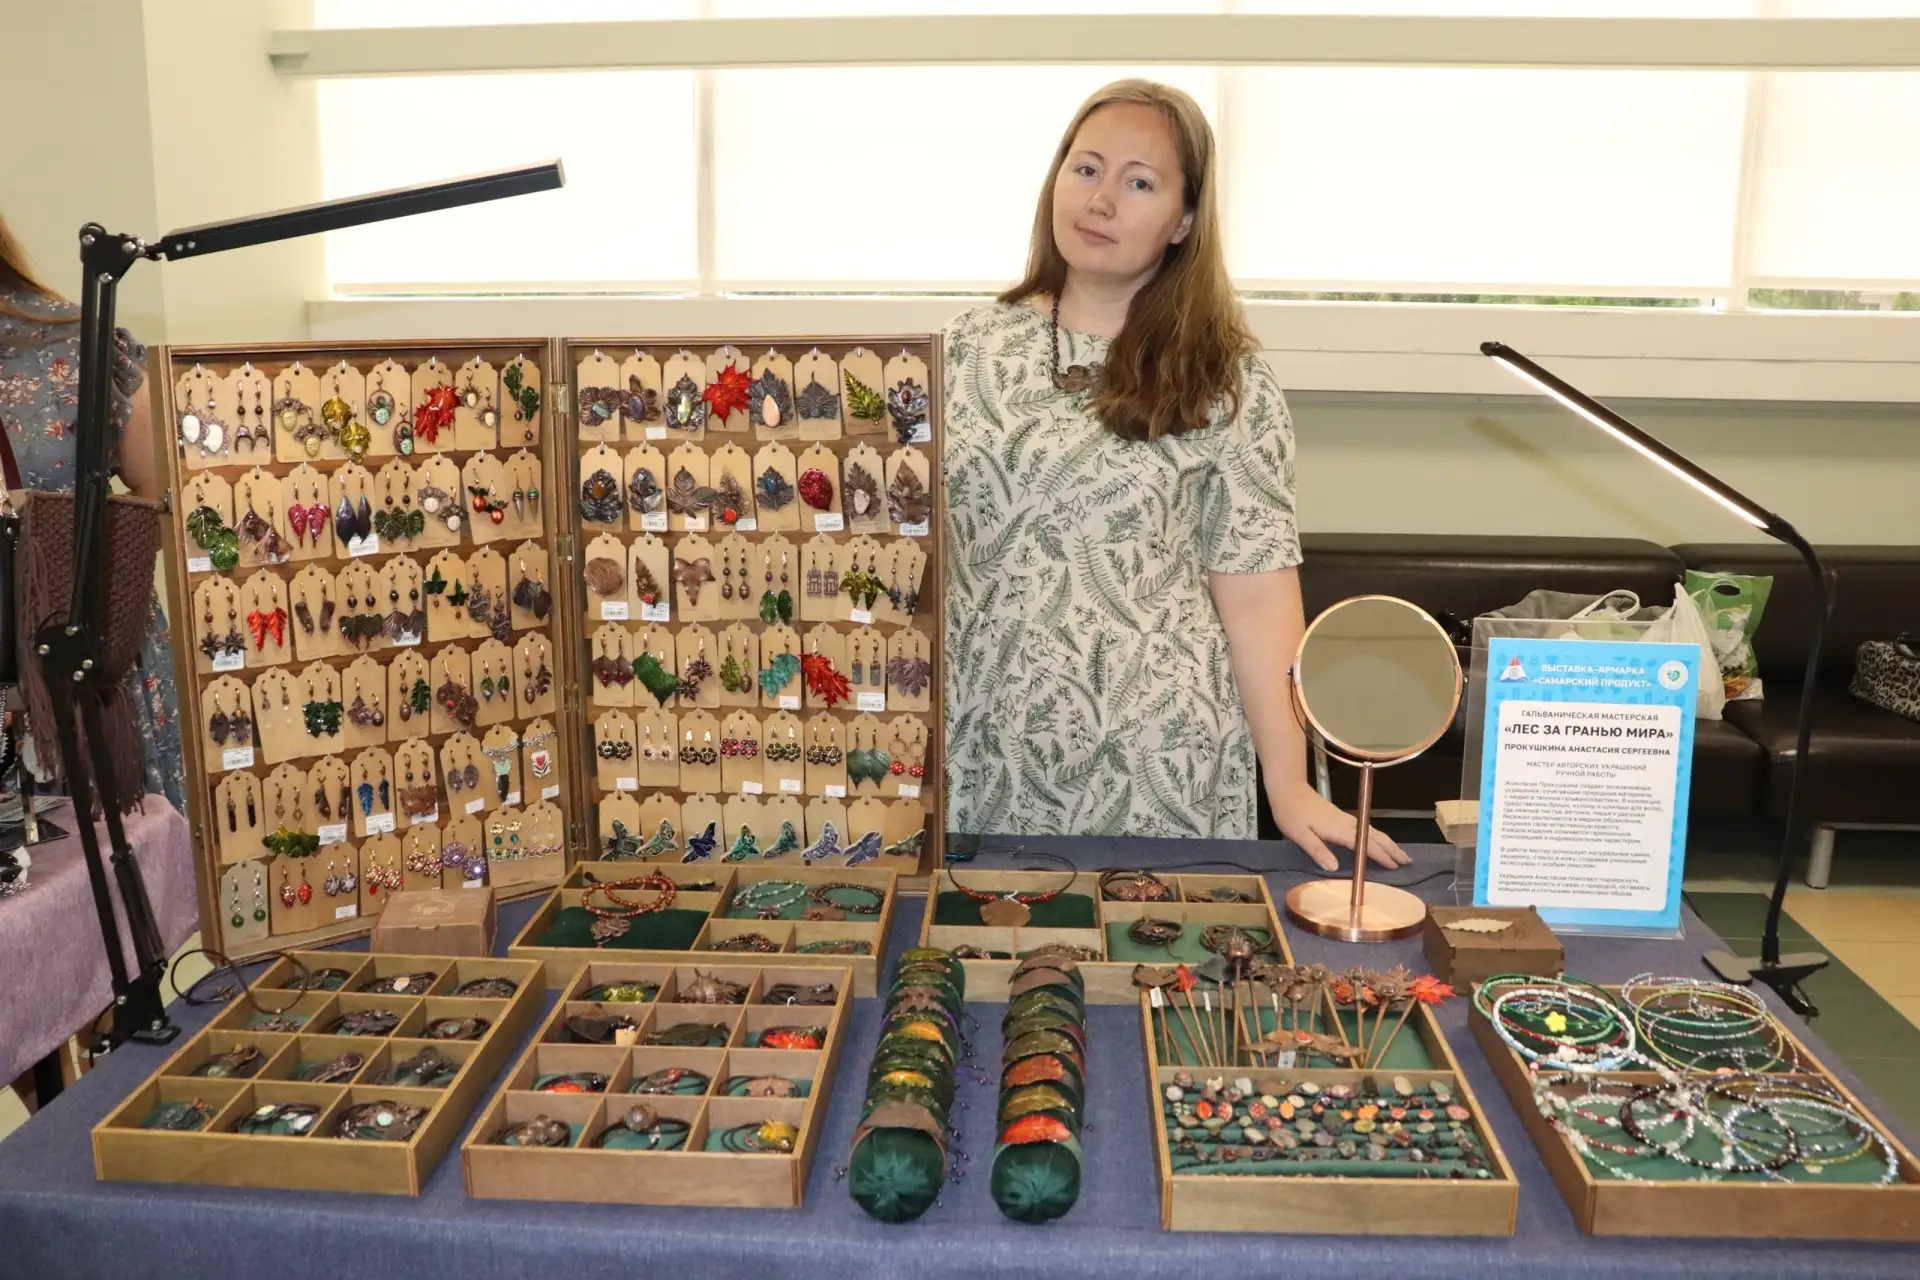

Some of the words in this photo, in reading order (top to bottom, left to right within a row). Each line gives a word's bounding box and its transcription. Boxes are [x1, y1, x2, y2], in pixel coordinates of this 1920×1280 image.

[1533, 675, 1599, 687] «САМАРСКИЙ
[1601, 678, 1652, 688] ПРОДУКТ»
[1521, 710, 1599, 720] ГАЛЬВАНИЧЕСКАЯ
[1601, 713, 1658, 721] МАСТЕРСКАЯ
[1504, 724, 1539, 735] «ЛЕС
[1543, 725, 1561, 736] ЗА
[1565, 726, 1622, 737] ГРАНЬЮ
[1626, 727, 1674, 739] МИРА»
[1504, 743, 1566, 753] ПРОКУШКИНА
[1568, 745, 1620, 754] АНАСТАСИЯ
[1621, 747, 1671, 756] СЕРГЕЕВНА
[1526, 761, 1555, 769] МАСТЕР
[1556, 762, 1600, 770] АВТОРСКИХ
[1601, 763, 1647, 771] УКРАШЕНИЙ
[1555, 768, 1585, 778] РУЧНОЙ
[1587, 770, 1616, 778] РАБОТЫ
